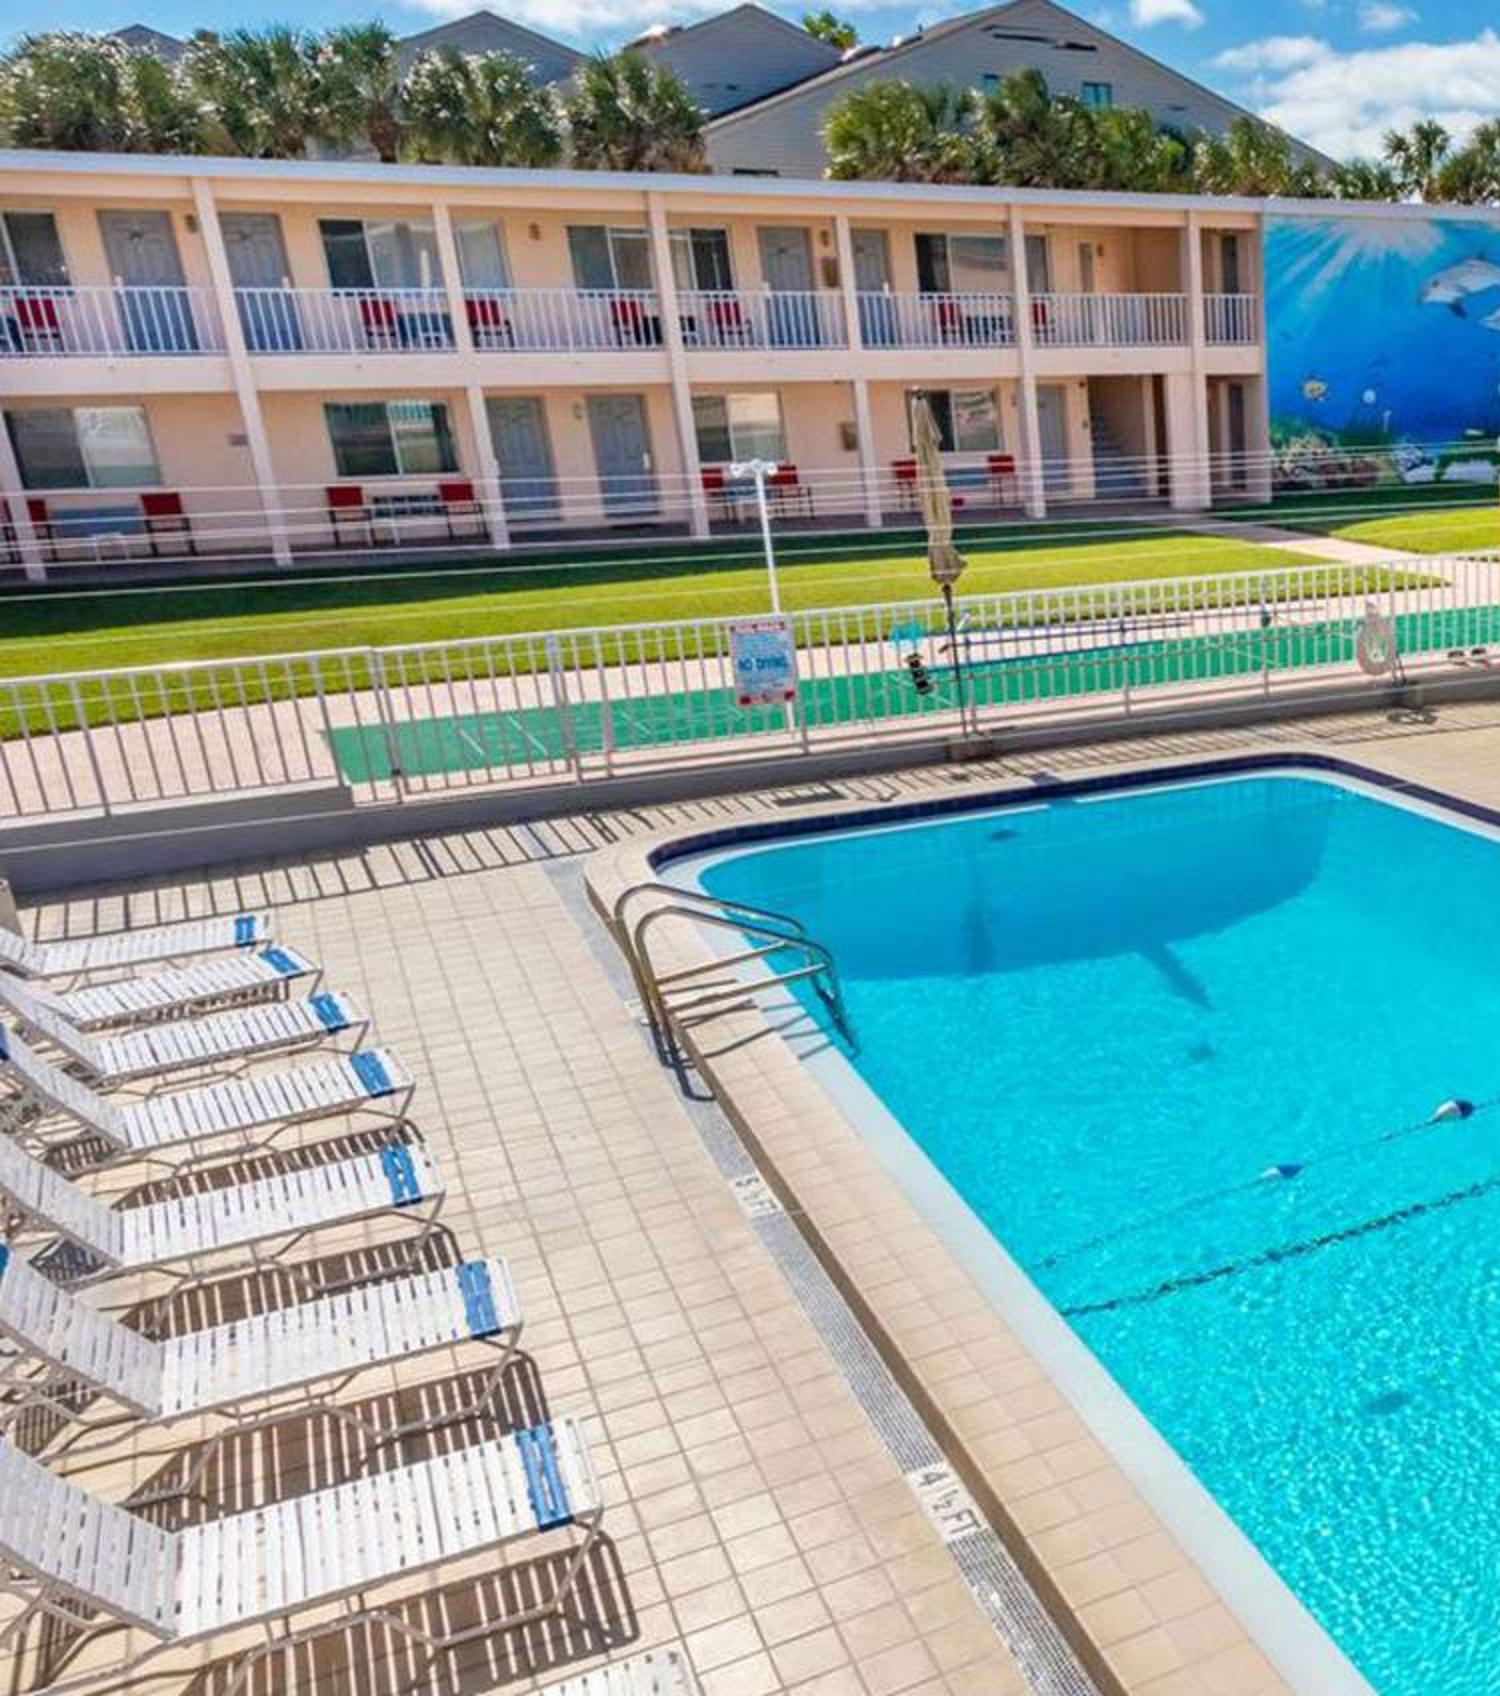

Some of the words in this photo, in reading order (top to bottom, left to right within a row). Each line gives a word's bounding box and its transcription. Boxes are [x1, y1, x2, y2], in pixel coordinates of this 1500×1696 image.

[737, 658, 753, 672] NO
[918, 1471, 951, 1488] 4
[938, 1507, 982, 1535] FT
